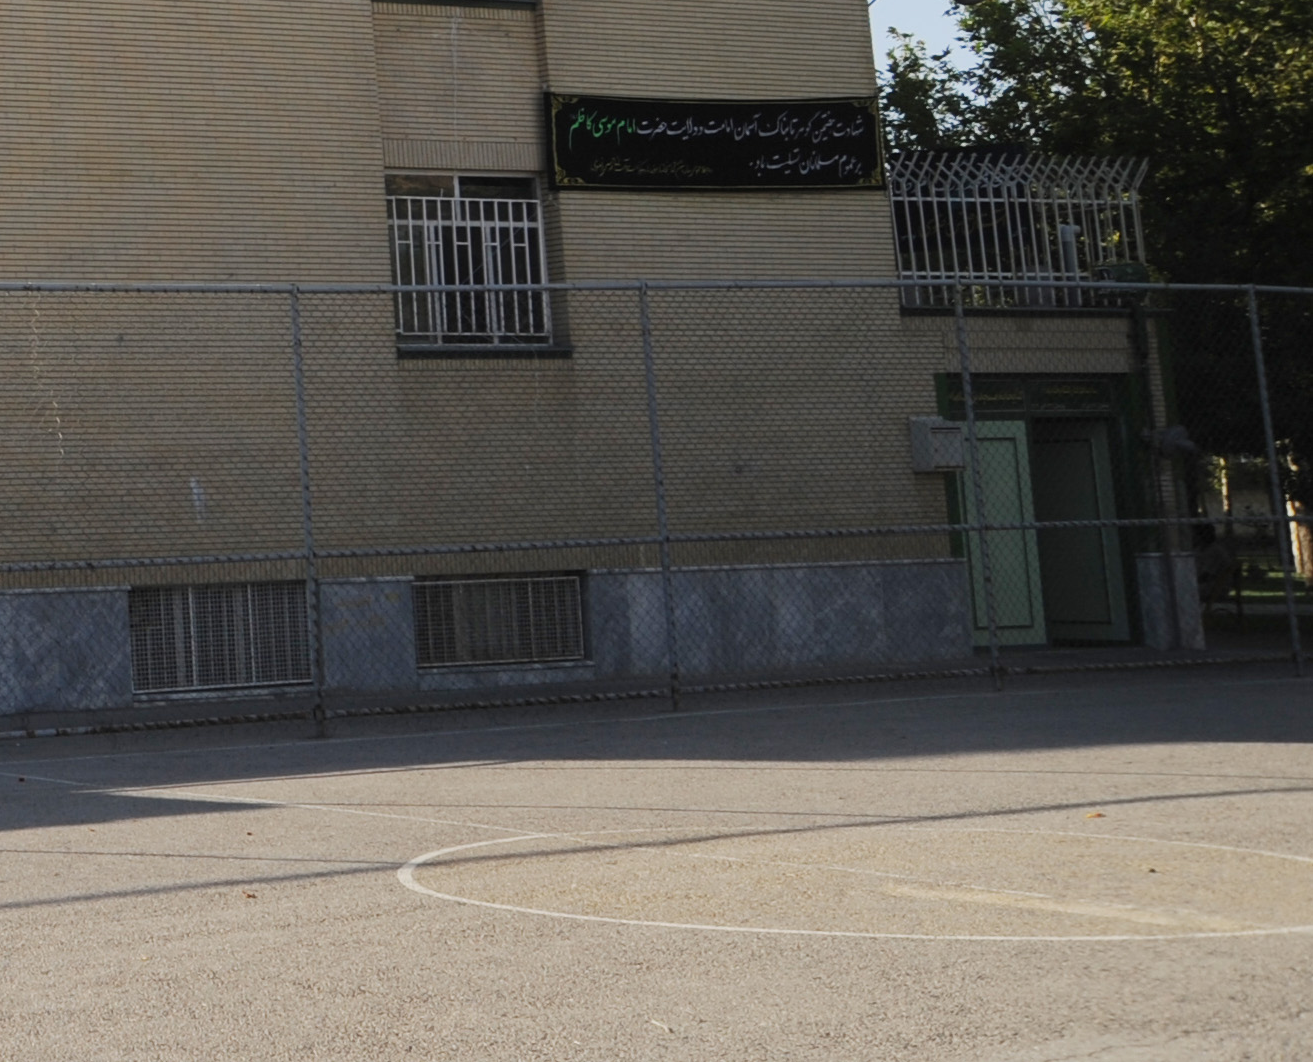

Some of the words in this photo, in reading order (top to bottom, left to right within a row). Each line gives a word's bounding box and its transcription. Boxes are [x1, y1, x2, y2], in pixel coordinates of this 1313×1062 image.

[569, 107, 598, 152] کاظم
[592, 115, 616, 138] موسی
[616, 117, 636, 146] امام
[636, 117, 668, 141] حضرت
[704, 117, 733, 134] امامت
[734, 112, 762, 141] آسمان
[758, 109, 798, 141] تابناک
[812, 110, 835, 143] هفتمین
[832, 114, 864, 137] شهادت
[766, 147, 800, 174] تسلیت
[799, 150, 839, 175] مسلمانان
[839, 153, 857, 177] عموم
[855, 157, 862, 175] بر
